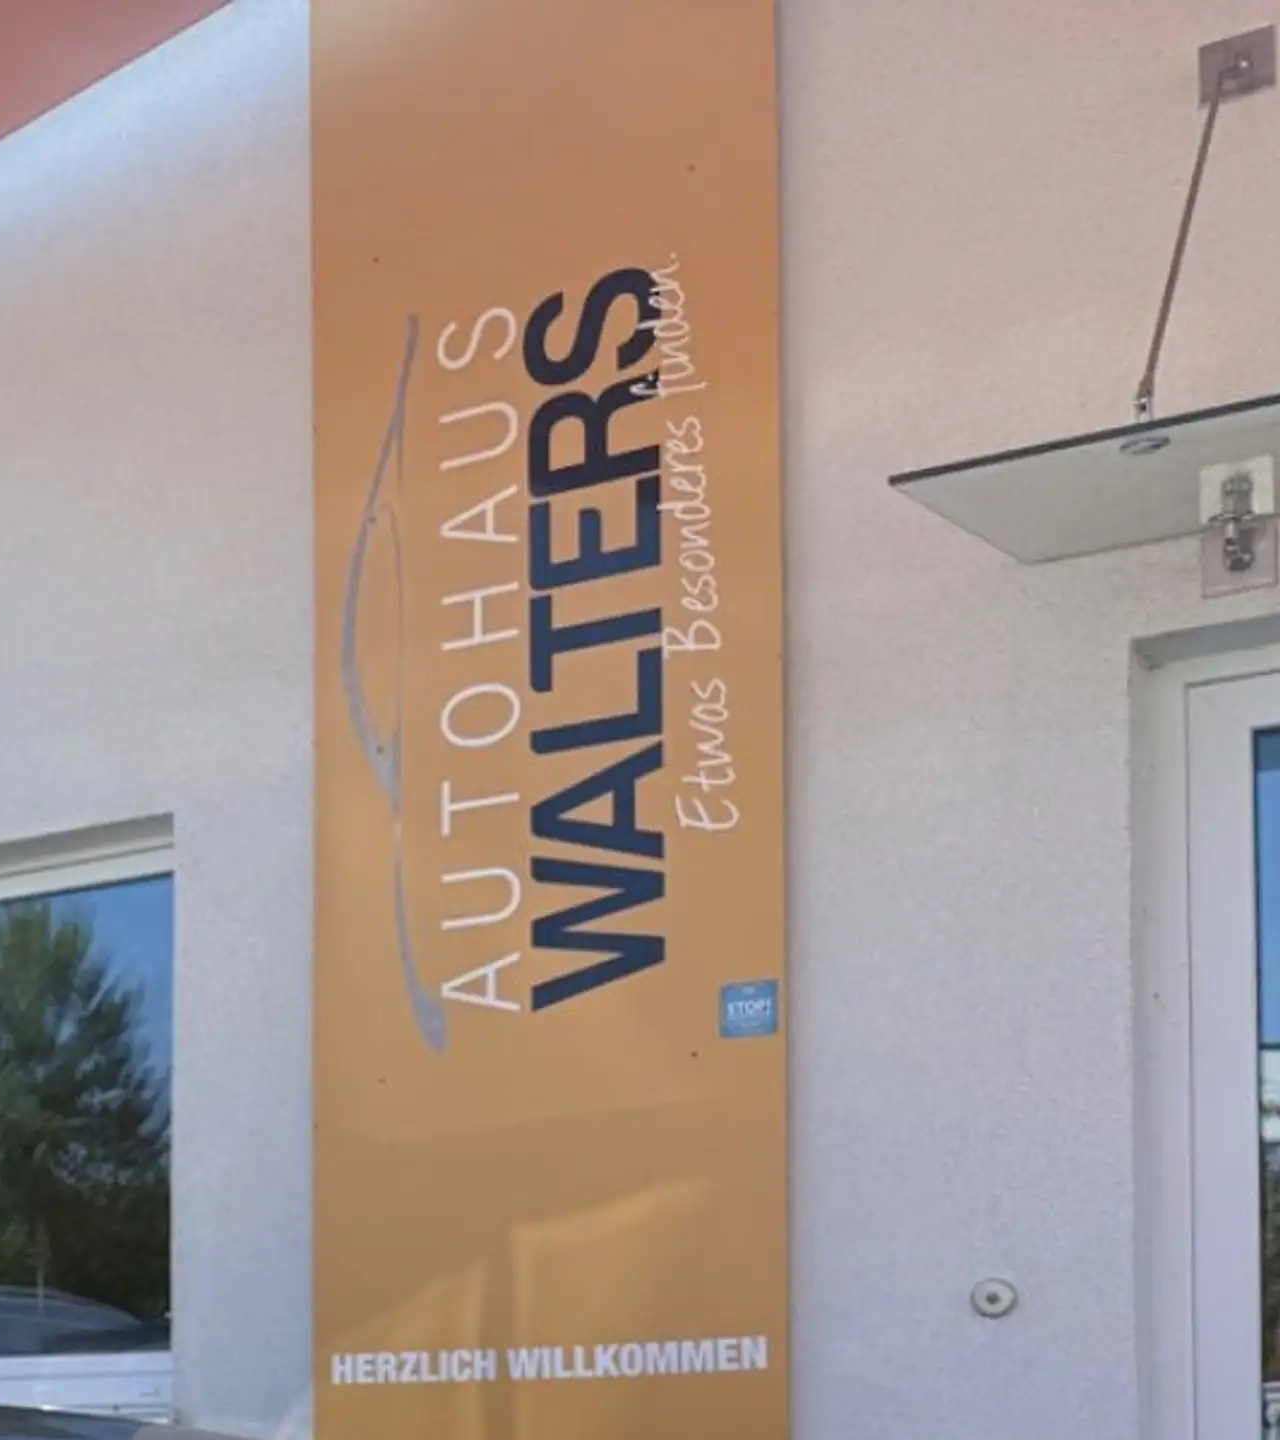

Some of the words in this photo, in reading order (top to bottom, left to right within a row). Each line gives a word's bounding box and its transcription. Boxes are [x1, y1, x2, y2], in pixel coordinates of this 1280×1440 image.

[628, 251, 709, 398] finden.
[656, 413, 723, 660] Besonderes
[437, 306, 522, 1012] AUTOHAUS
[523, 267, 666, 1013] WALTERS
[675, 677, 740, 832] Etwas
[330, 1348, 497, 1386] HERZLICH
[506, 1336, 769, 1381] WILLKOMMEN
